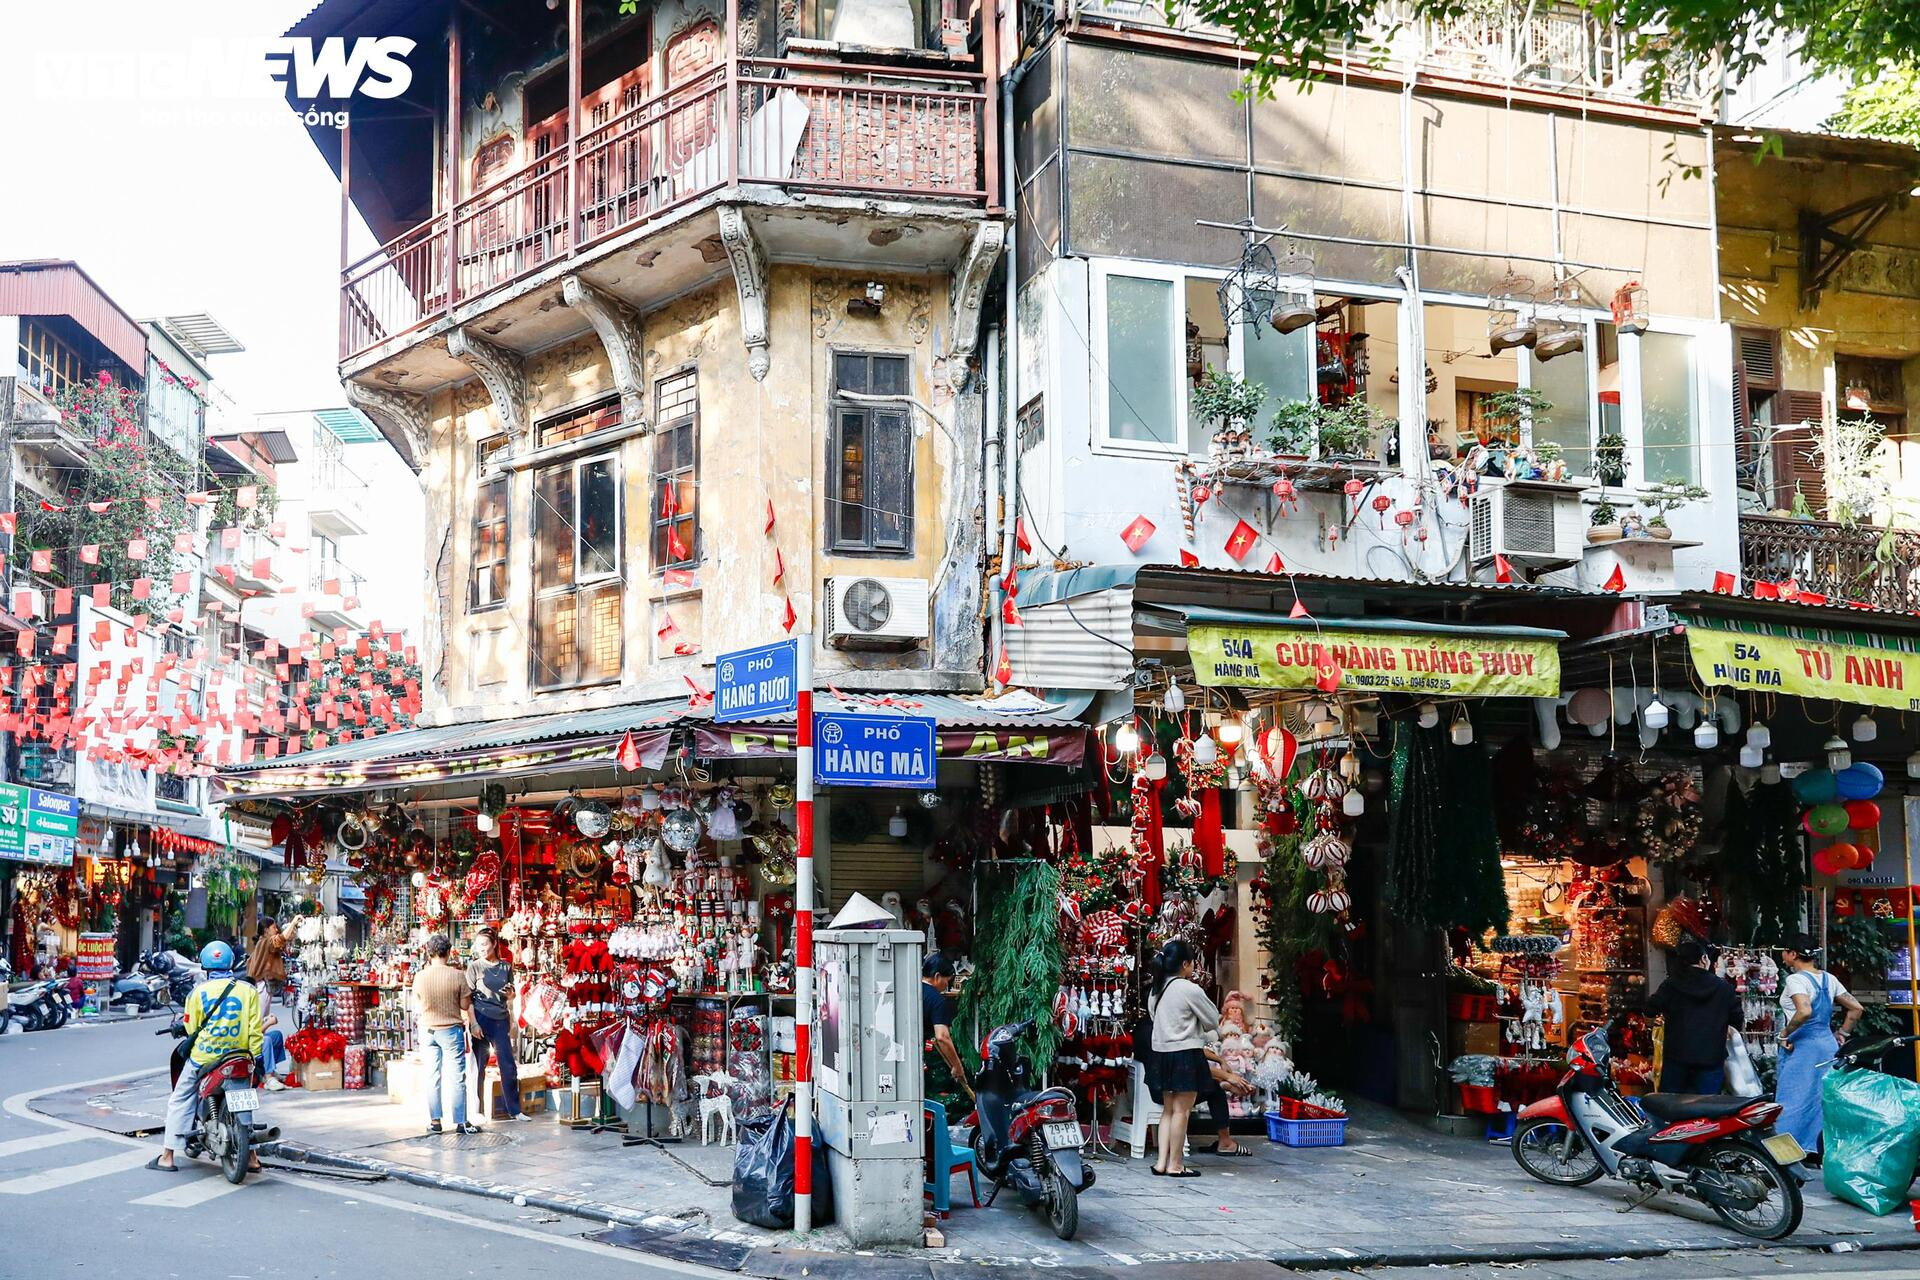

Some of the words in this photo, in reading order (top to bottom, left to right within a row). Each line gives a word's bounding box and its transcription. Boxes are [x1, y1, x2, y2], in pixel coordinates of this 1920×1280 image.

[1222, 638, 1253, 660] 54A
[1332, 640, 1396, 671] HÀNG
[1401, 640, 1473, 675] THẮNG
[1734, 643, 1761, 662] 54
[747, 651, 774, 673] PHỐ
[1214, 661, 1243, 678] HÀNG
[1245, 664, 1260, 679] MÃ
[1795, 645, 1832, 681] TÚ
[1844, 654, 1904, 691] ANH
[1355, 675, 1374, 686] 0903
[1375, 676, 1389, 687] 225
[1756, 668, 1782, 686] MÃ
[722, 683, 755, 710] HÀNG
[759, 676, 790, 705] RƯƠI
[864, 724, 901, 741] PHỐ
[825, 744, 884, 775] HÀNG
[891, 748, 925, 776] MÃ
[37, 793, 70, 812] Salonpas
[20, 809, 28, 827] 1
[201, 991, 242, 1020] be
[1048, 1123, 1077, 1135] 29-P9
[1053, 1134, 1080, 1147] 4240
